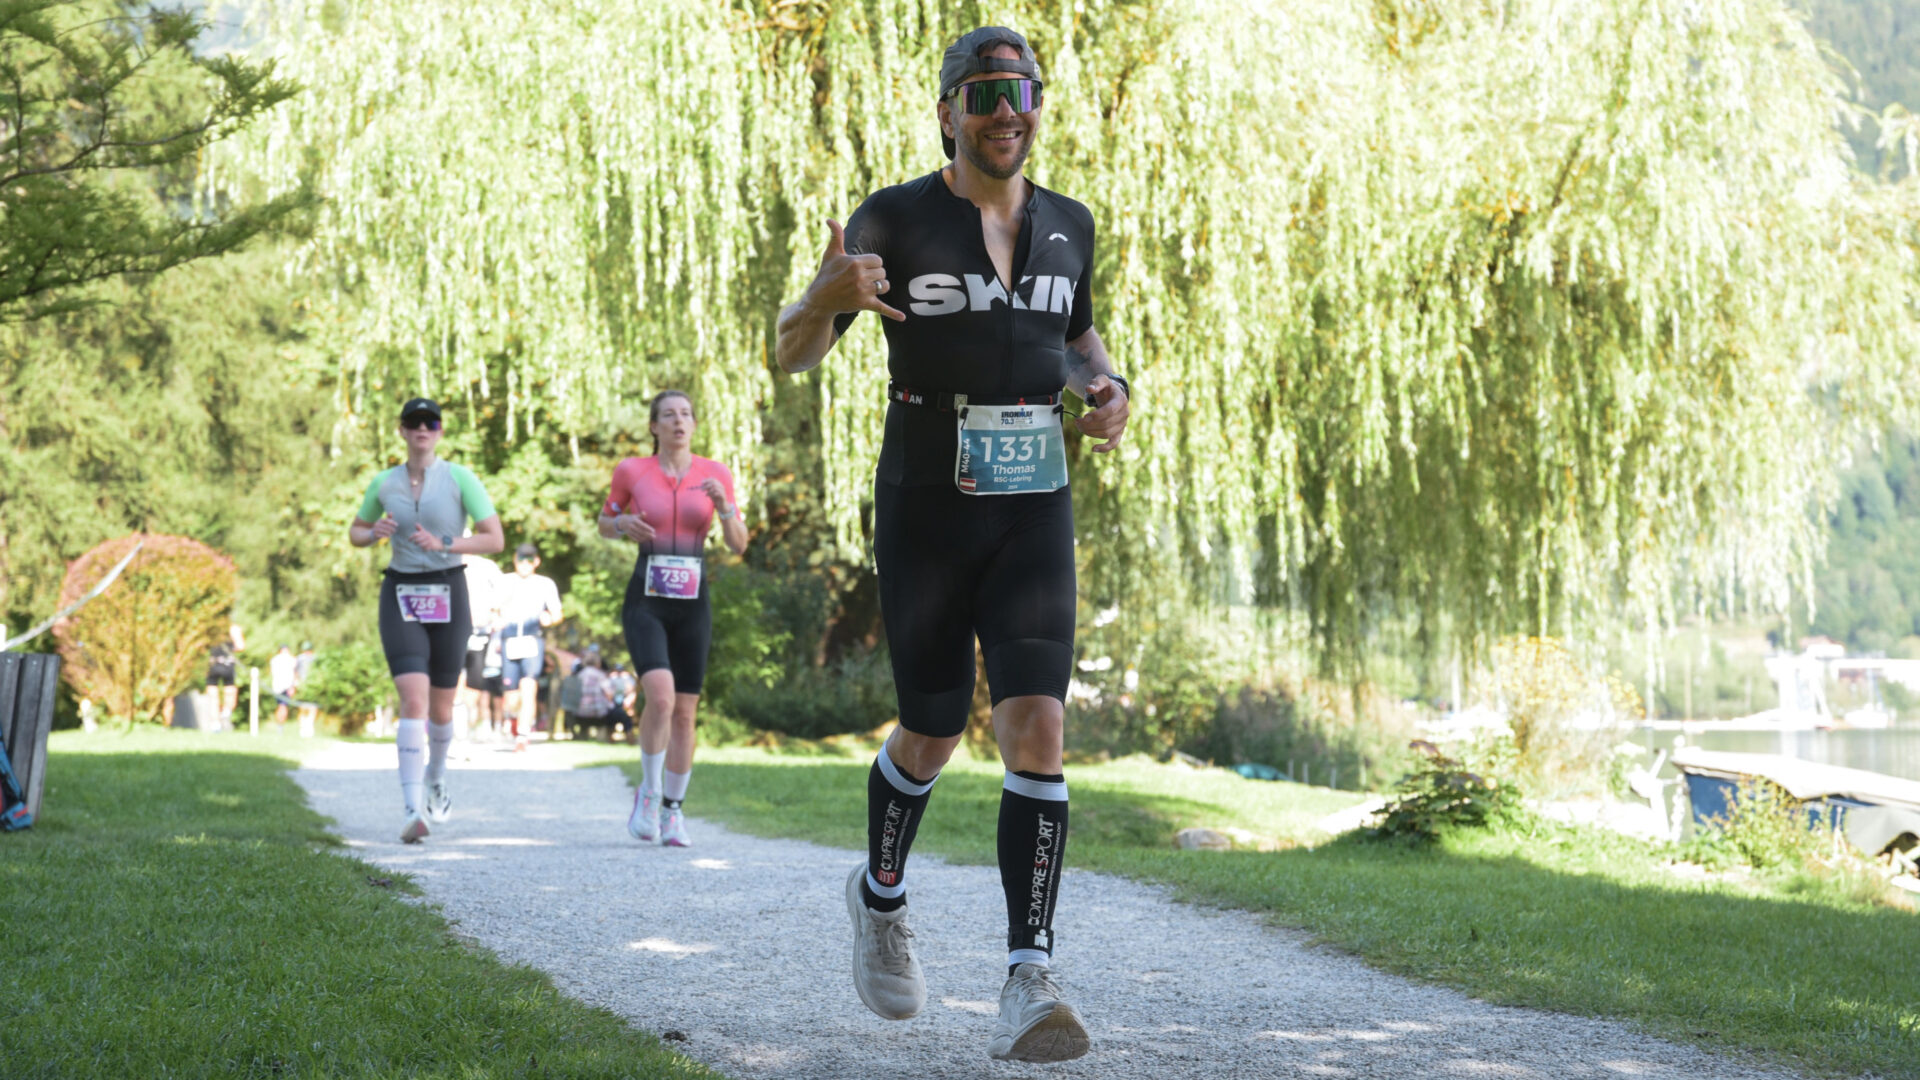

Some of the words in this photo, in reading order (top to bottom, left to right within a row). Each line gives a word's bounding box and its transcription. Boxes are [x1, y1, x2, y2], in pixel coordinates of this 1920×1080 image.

[961, 438, 971, 473] M40-44
[981, 434, 1047, 463] 1331
[992, 464, 1036, 475] Thomas
[660, 568, 690, 584] 739
[410, 597, 437, 609] 736
